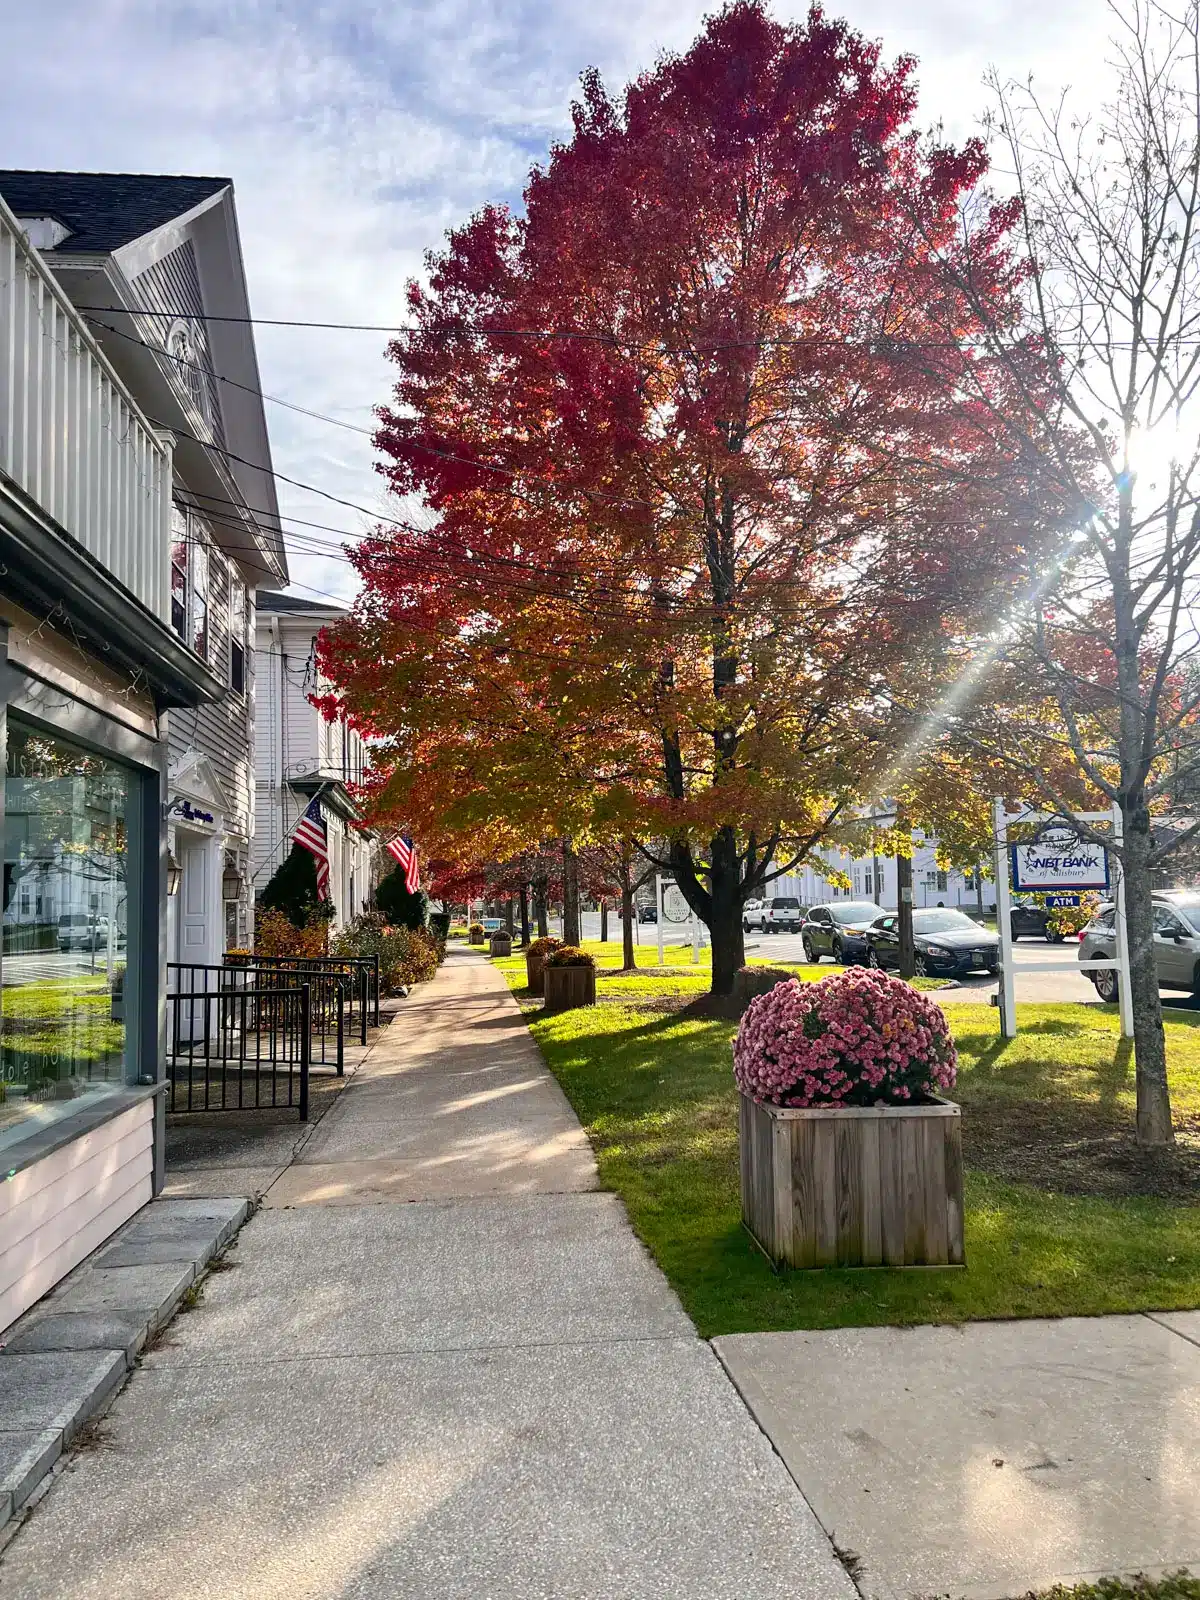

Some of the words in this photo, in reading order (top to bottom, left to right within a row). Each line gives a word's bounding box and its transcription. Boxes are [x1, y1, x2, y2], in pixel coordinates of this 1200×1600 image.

[1034, 857, 1062, 868] NBT
[1062, 857, 1098, 868] BANK
[1053, 898, 1073, 906] ATM
